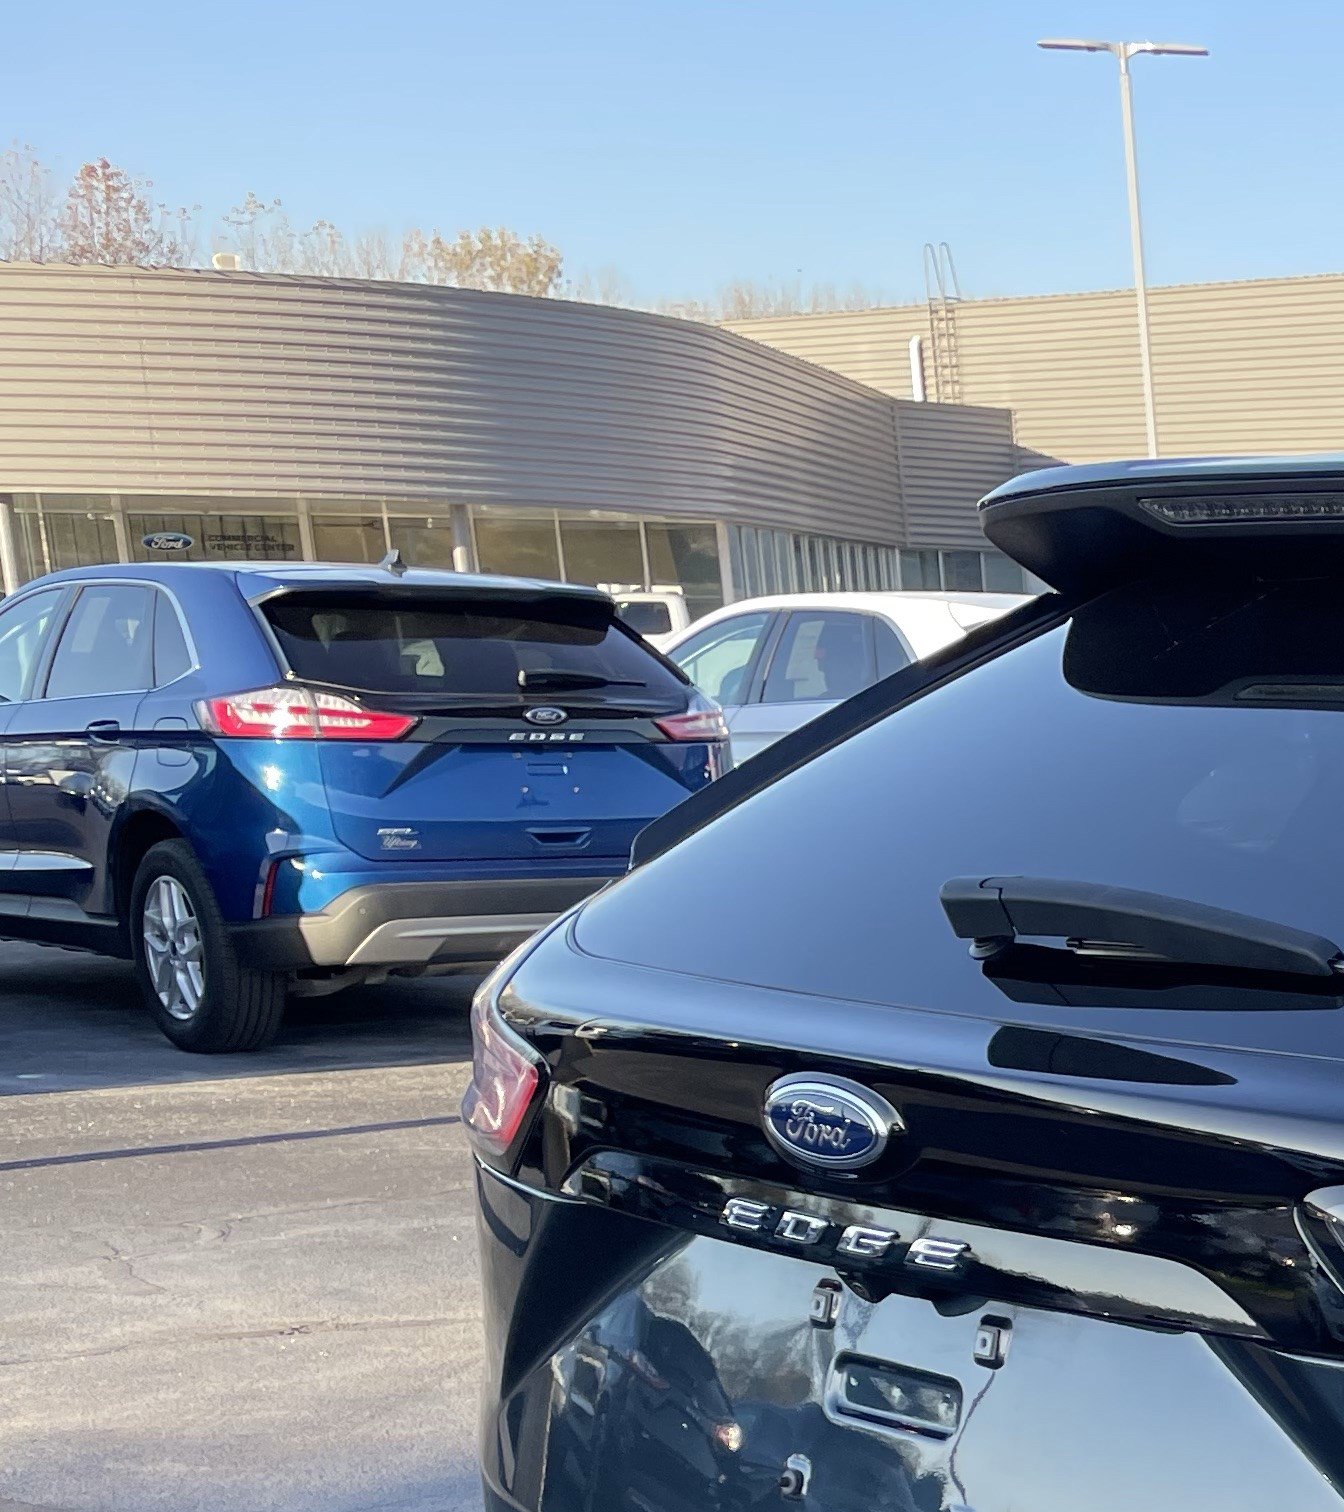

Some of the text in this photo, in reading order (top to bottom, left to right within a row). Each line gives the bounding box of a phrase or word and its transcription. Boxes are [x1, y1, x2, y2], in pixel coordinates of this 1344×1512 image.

[150, 535, 184, 549] Ford
[207, 534, 277, 543] COMMERCIAL
[255, 544, 295, 552] CENTER
[508, 732, 585, 741] EDGE
[785, 1098, 852, 1149] Ford
[718, 1196, 972, 1272] EDGE
